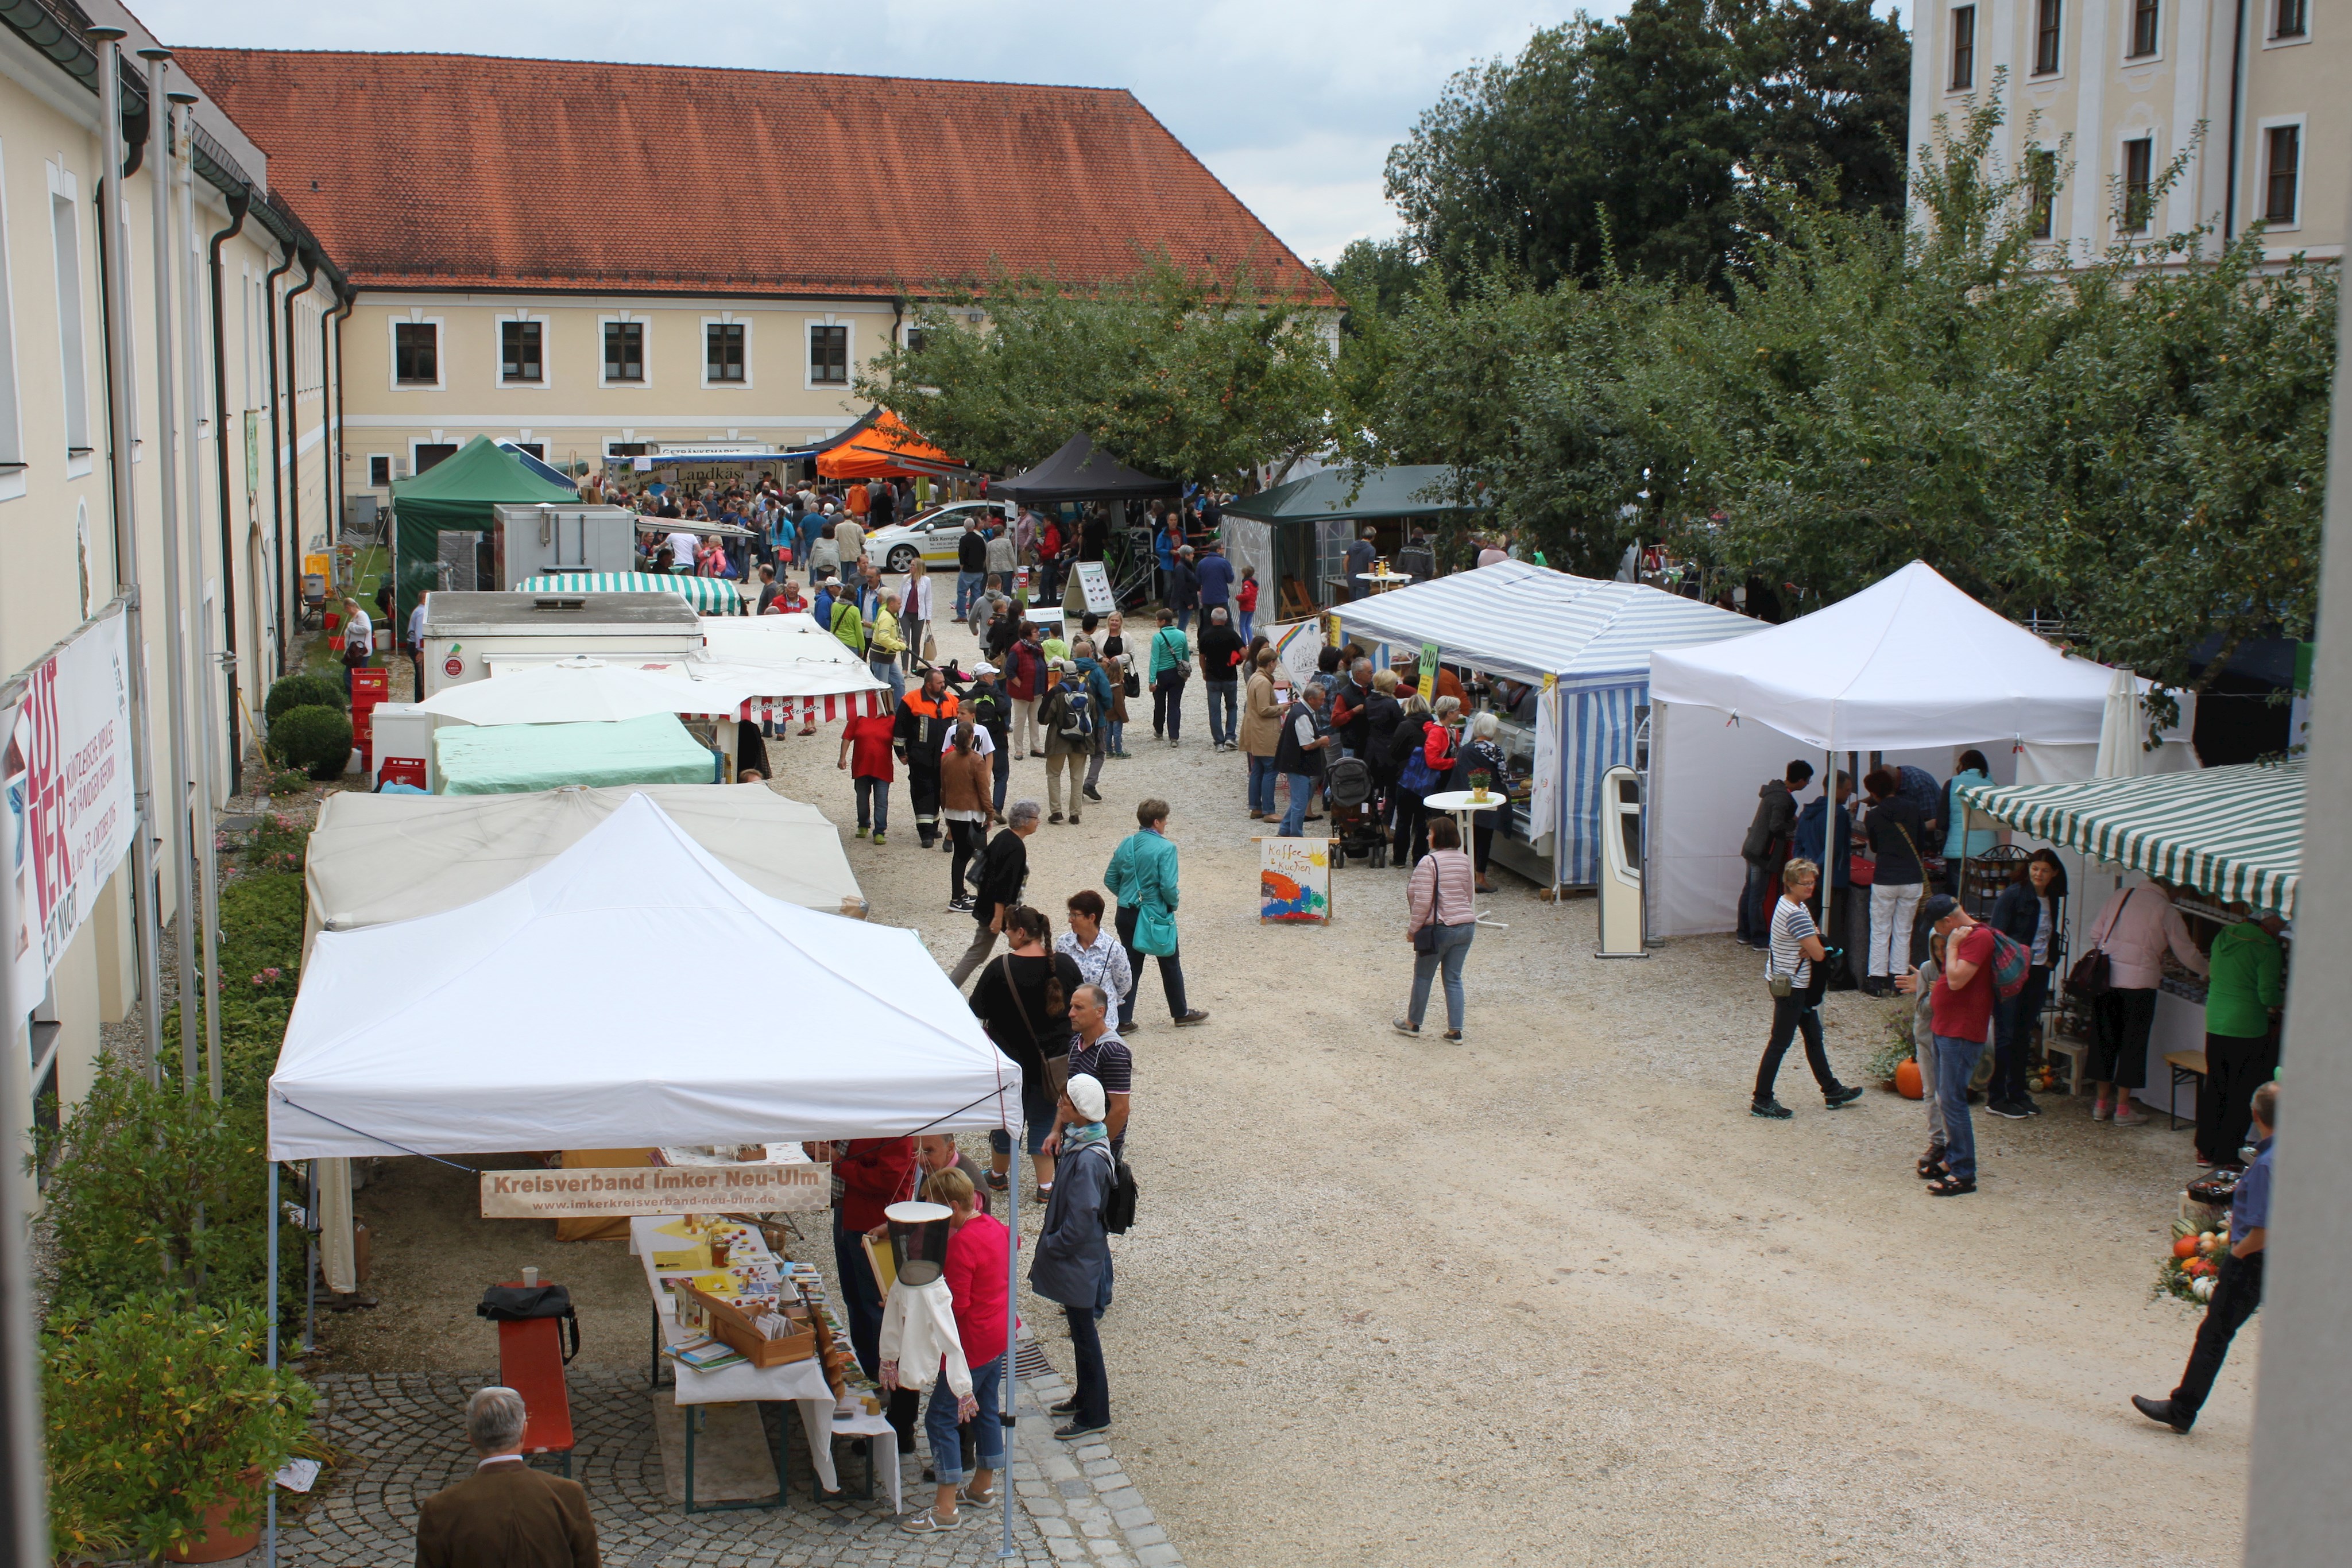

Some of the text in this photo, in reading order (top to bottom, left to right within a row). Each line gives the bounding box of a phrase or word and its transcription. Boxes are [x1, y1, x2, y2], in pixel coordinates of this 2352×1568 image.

[1422, 649, 1436, 668] BIO
[751, 699, 794, 713] Biofeinkost
[790, 706, 821, 715] Feinsten
[94, 812, 109, 849] OKTOBER
[1268, 844, 1302, 859] Kaffee
[1278, 861, 1312, 875] Kuchen
[58, 881, 77, 944] NICHT
[494, 1168, 819, 1194] Kreisverband Imker Neu-Ulm
[532, 1194, 776, 1211] www.imkerkreisverband-neu-ulm.de
